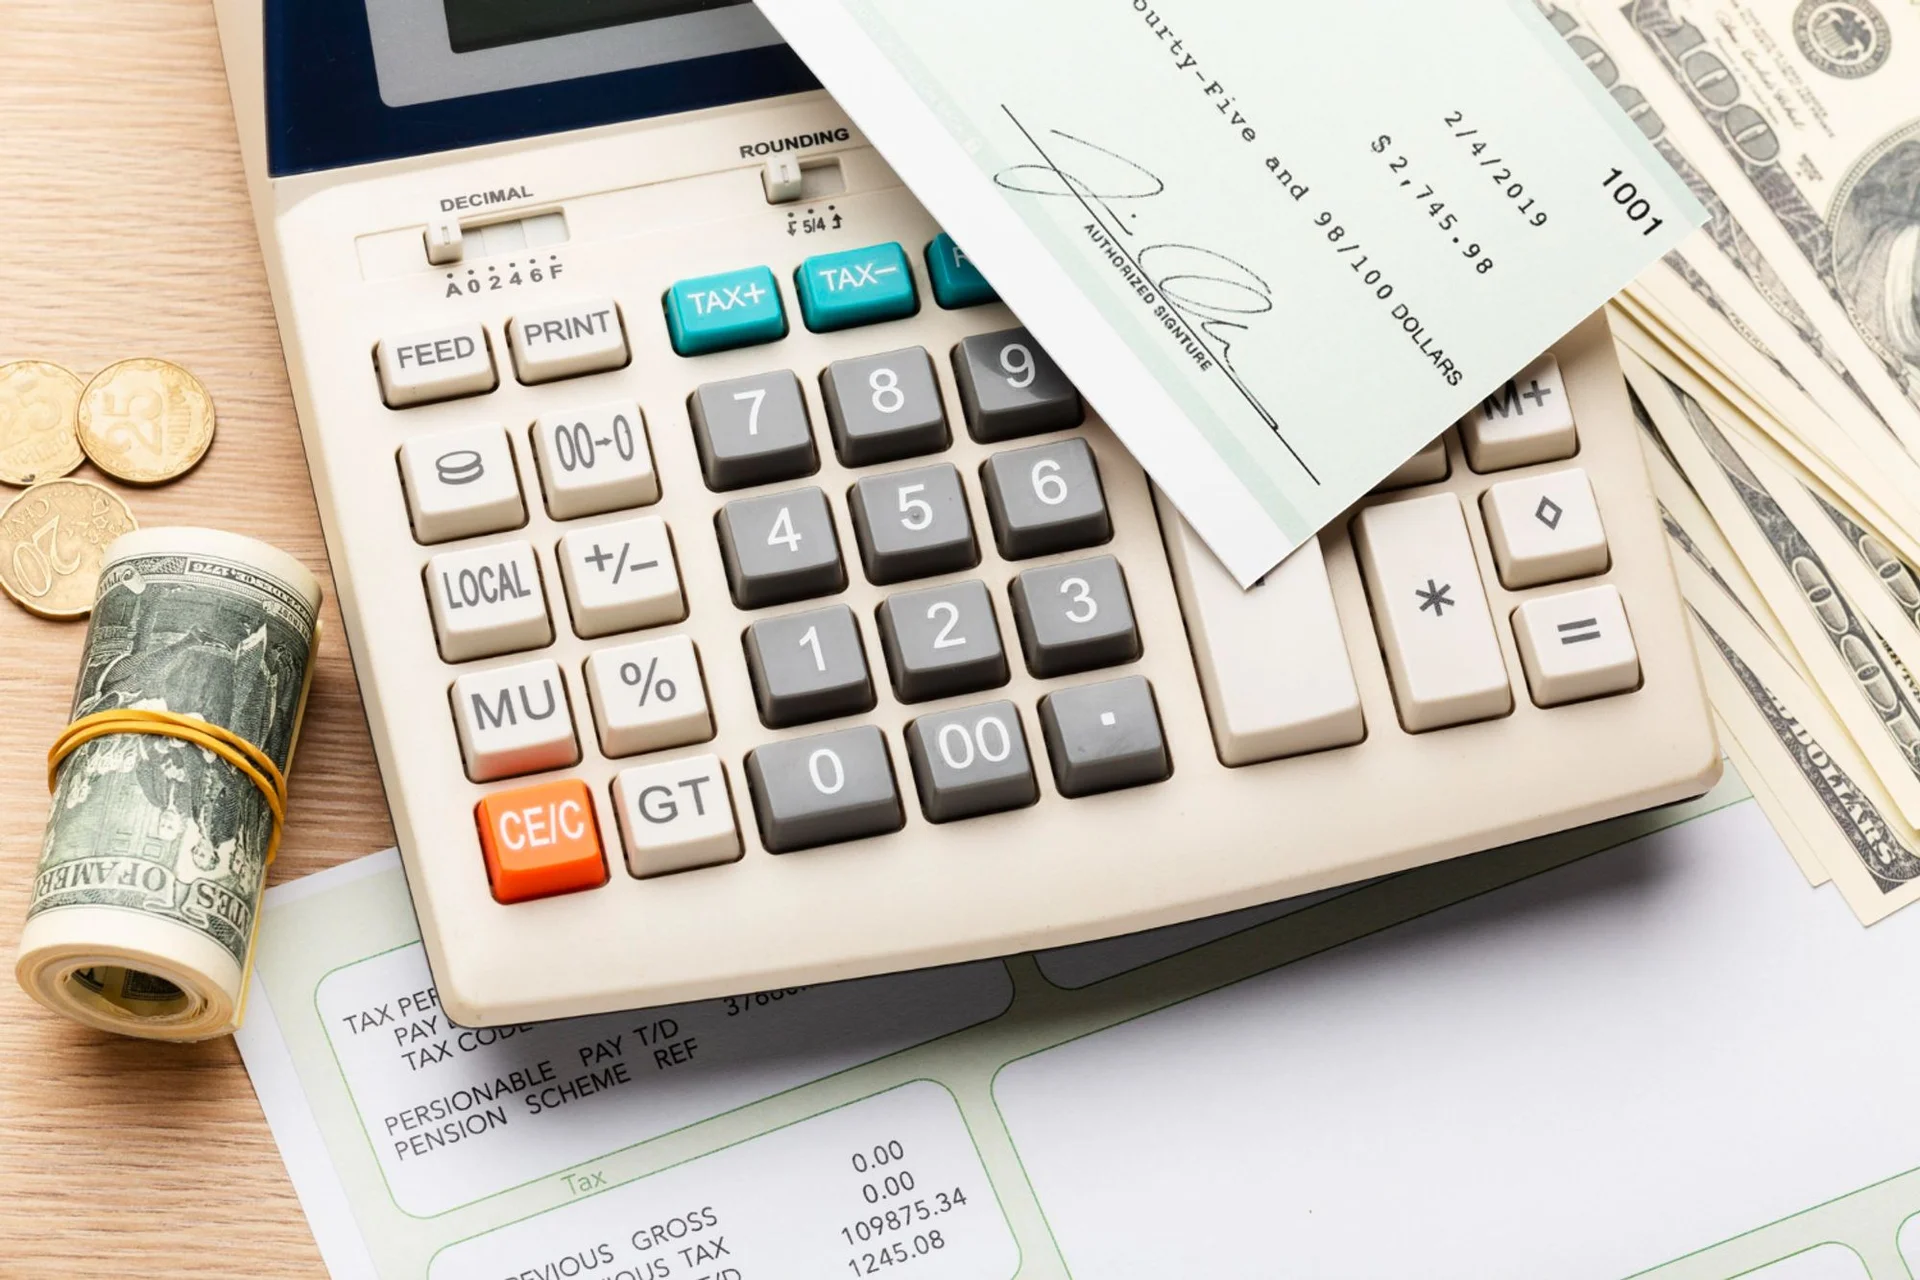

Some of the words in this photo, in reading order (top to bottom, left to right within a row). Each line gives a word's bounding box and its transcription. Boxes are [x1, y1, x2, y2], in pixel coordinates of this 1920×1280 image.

[739, 128, 850, 159] ROUNDING
[1444, 110, 1548, 227] 2/4/2019
[440, 185, 534, 212] DECIMAL
[1602, 167, 1664, 236] 1001
[1265, 156, 1309, 201] and
[1314, 211, 1394, 300] 98/100
[1391, 303, 1463, 387] DOLLARS
[687, 282, 766, 315] TAX+
[1084, 223, 1155, 304] AUTHORIZED
[1154, 305, 1213, 371] SIGNTURE
[524, 310, 610, 346] PRINT
[397, 335, 475, 369] FEED
[999, 343, 1036, 388] 9
[733, 388, 767, 435] 7
[868, 368, 905, 414] 8
[1481, 379, 1552, 421] M+
[1031, 459, 1068, 506] 6
[766, 506, 803, 553] 4
[898, 483, 934, 531] 5
[442, 560, 532, 610] LOCAL
[1059, 576, 1098, 624] 3
[798, 625, 827, 672] 1
[926, 601, 967, 650] 2
[470, 679, 557, 731] MU
[619, 657, 677, 707] %
[937, 715, 1012, 770] 00
[807, 748, 846, 796] 0
[638, 776, 711, 825] GT
[499, 800, 585, 850] CE/C
[343, 1003, 395, 1034] TAX
[394, 1015, 437, 1047] PAY
[401, 1040, 454, 1071] TAX
[458, 1023, 533, 1052] COD
[383, 1060, 557, 1137] PERSIONABLE
[578, 1035, 625, 1067] PAY
[633, 1018, 680, 1048] T/D
[393, 1106, 508, 1161] PENSION
[525, 1066, 632, 1115] SCHEME
[653, 1038, 700, 1071] REF
[852, 1140, 904, 1173] 0.00
[559, 1169, 609, 1197] Tax
[863, 1171, 914, 1204] 0.00
[632, 1206, 718, 1251] GROSS
[841, 1187, 967, 1245] 109875.34
[678, 1236, 731, 1268] TAX
[849, 1230, 945, 1277] 1245.08
